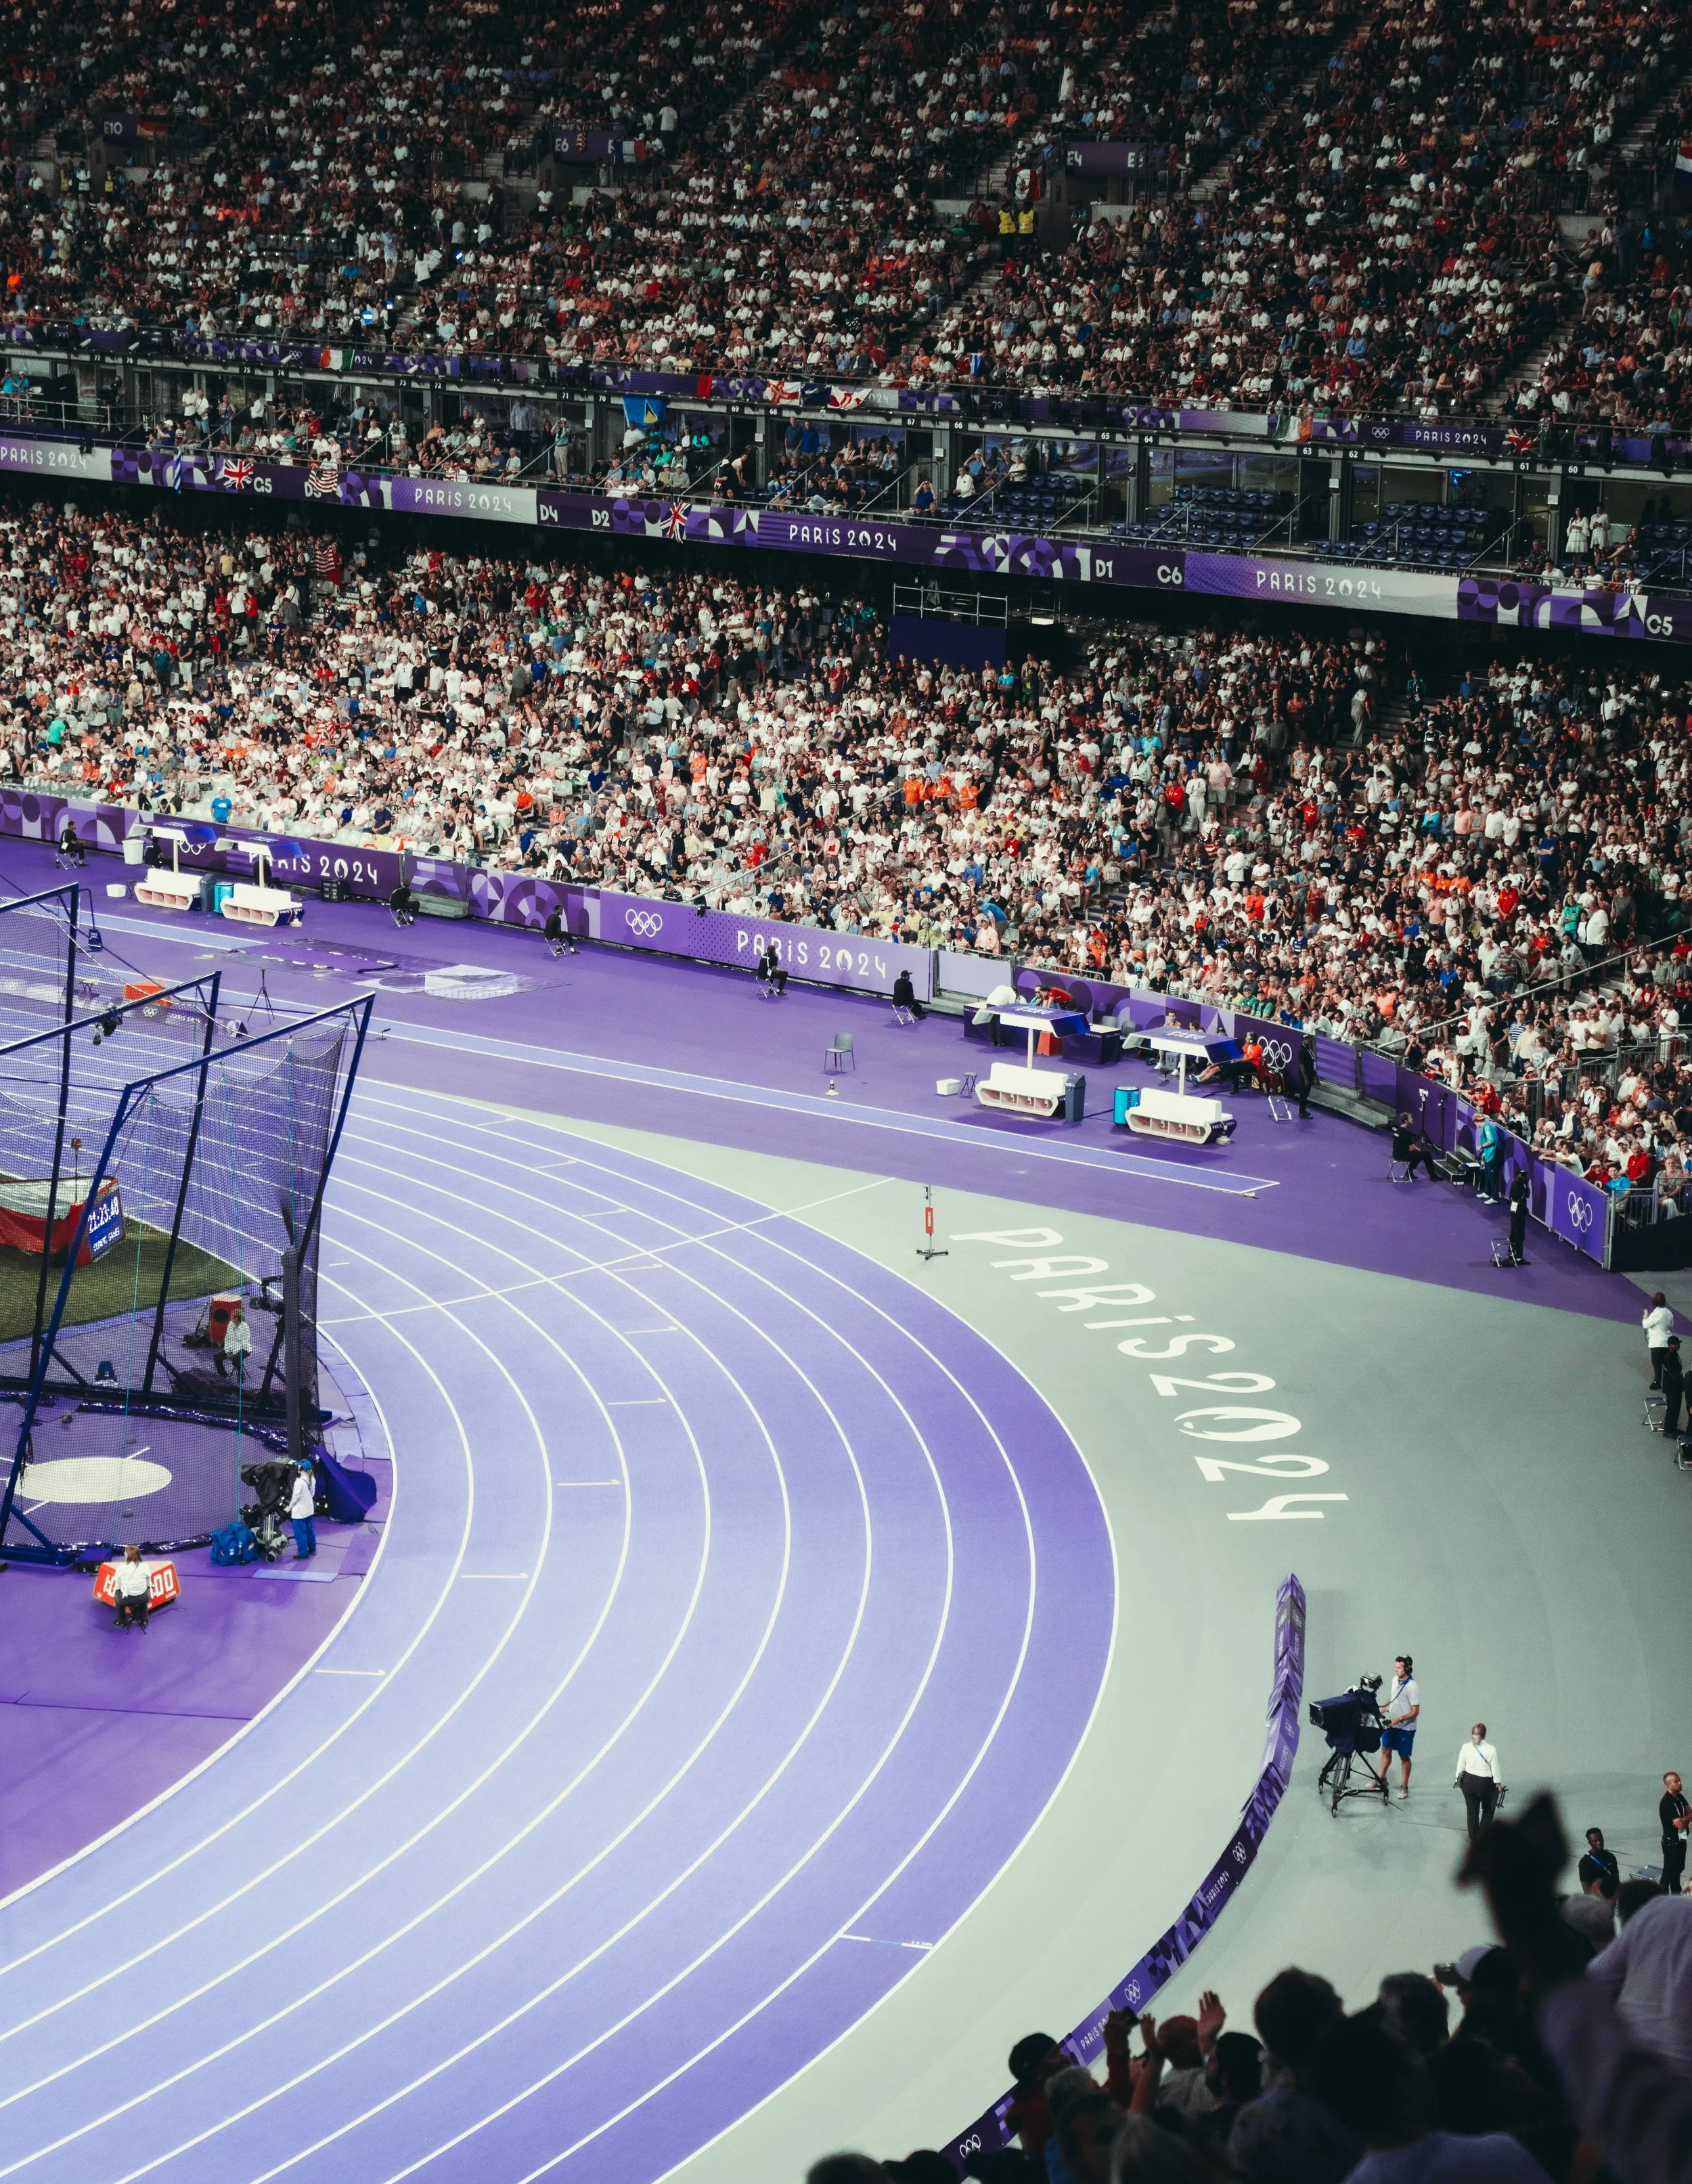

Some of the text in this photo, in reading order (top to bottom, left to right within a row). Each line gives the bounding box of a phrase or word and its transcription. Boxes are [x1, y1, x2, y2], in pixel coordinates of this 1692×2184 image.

[104, 121, 123, 135] E10
[555, 137, 569, 152] E6
[1067, 150, 1082, 166] E4
[1144, 435, 1153, 443] 64
[1455, 432, 1487, 445] 2024
[49, 451, 86, 469] 2024
[1520, 462, 1529, 470] 61
[1568, 466, 1578, 474] 60
[468, 493, 511, 512] 2024
[539, 504, 558, 522] D4
[592, 509, 610, 527] D2
[847, 529, 897, 551] 2024
[1096, 559, 1113, 578] D1
[1157, 565, 1182, 585] C6
[1325, 577, 1381, 599] 2024
[1646, 614, 1673, 636] C5
[319, 855, 378, 885] 2024
[819, 945, 886, 979] 2024
[1149, 1371, 1350, 1521] 2024
[1217, 1870, 1230, 1889] 2024
